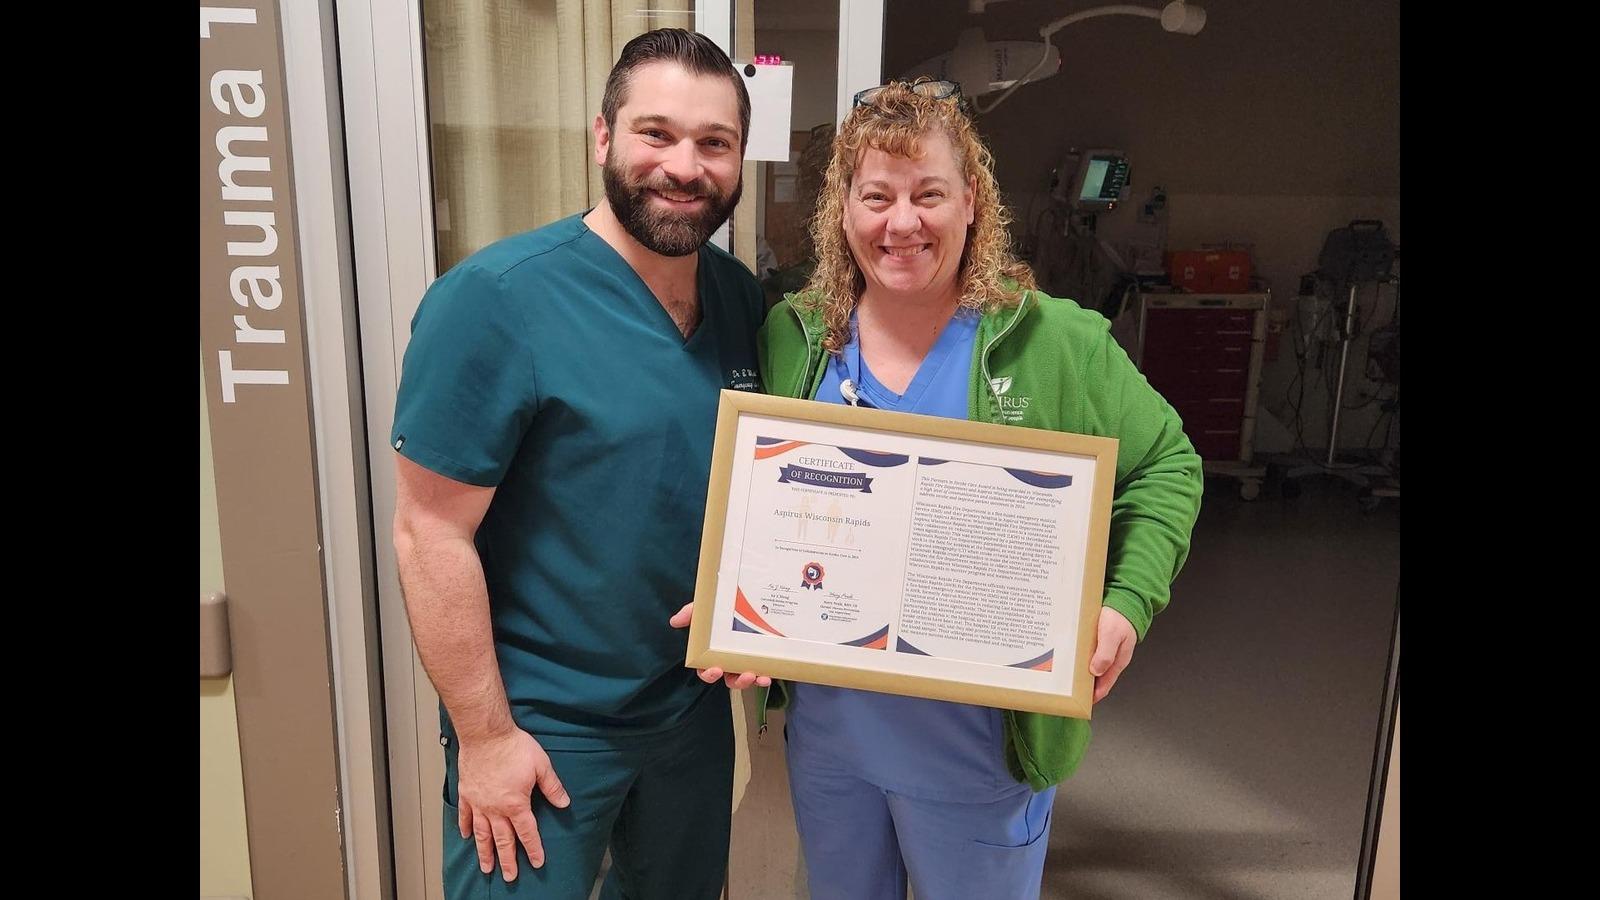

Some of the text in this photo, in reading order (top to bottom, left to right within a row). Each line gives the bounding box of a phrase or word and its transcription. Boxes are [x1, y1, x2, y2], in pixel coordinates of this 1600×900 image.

[210, 69, 289, 403] Trauma
[999, 396, 1029, 408] IRUS
[798, 456, 855, 470] CERTIFICATE
[790, 469, 862, 486] OF RECOGNITION
[773, 508, 871, 528] Aspirus Wisconsin Rapids
